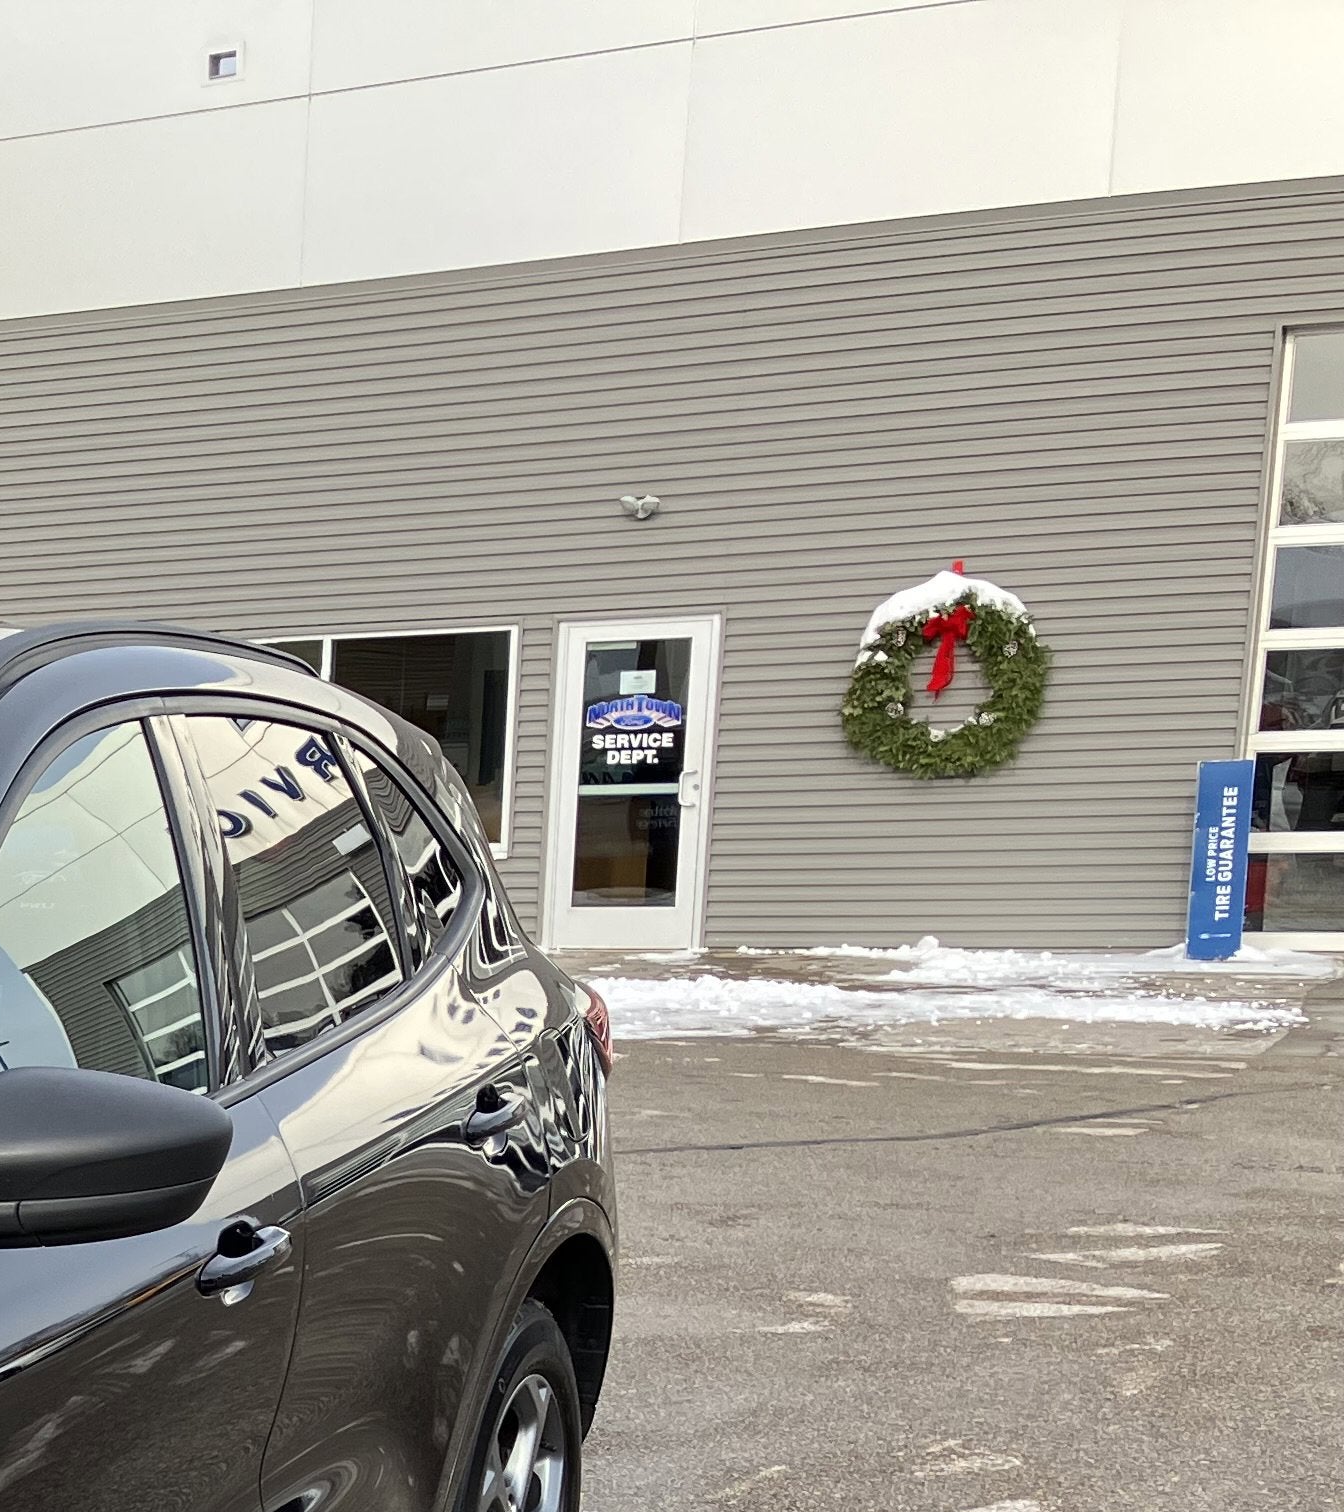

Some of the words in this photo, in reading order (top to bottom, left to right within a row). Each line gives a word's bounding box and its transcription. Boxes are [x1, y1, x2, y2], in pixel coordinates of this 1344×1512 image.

[591, 733, 674, 749] SERVICE
[606, 750, 659, 764] DEPT.
[1208, 826, 1219, 857] PRICE
[1217, 786, 1239, 882] GUARANTEE
[1206, 859, 1217, 882] LOW
[1214, 885, 1232, 921] TIRE
